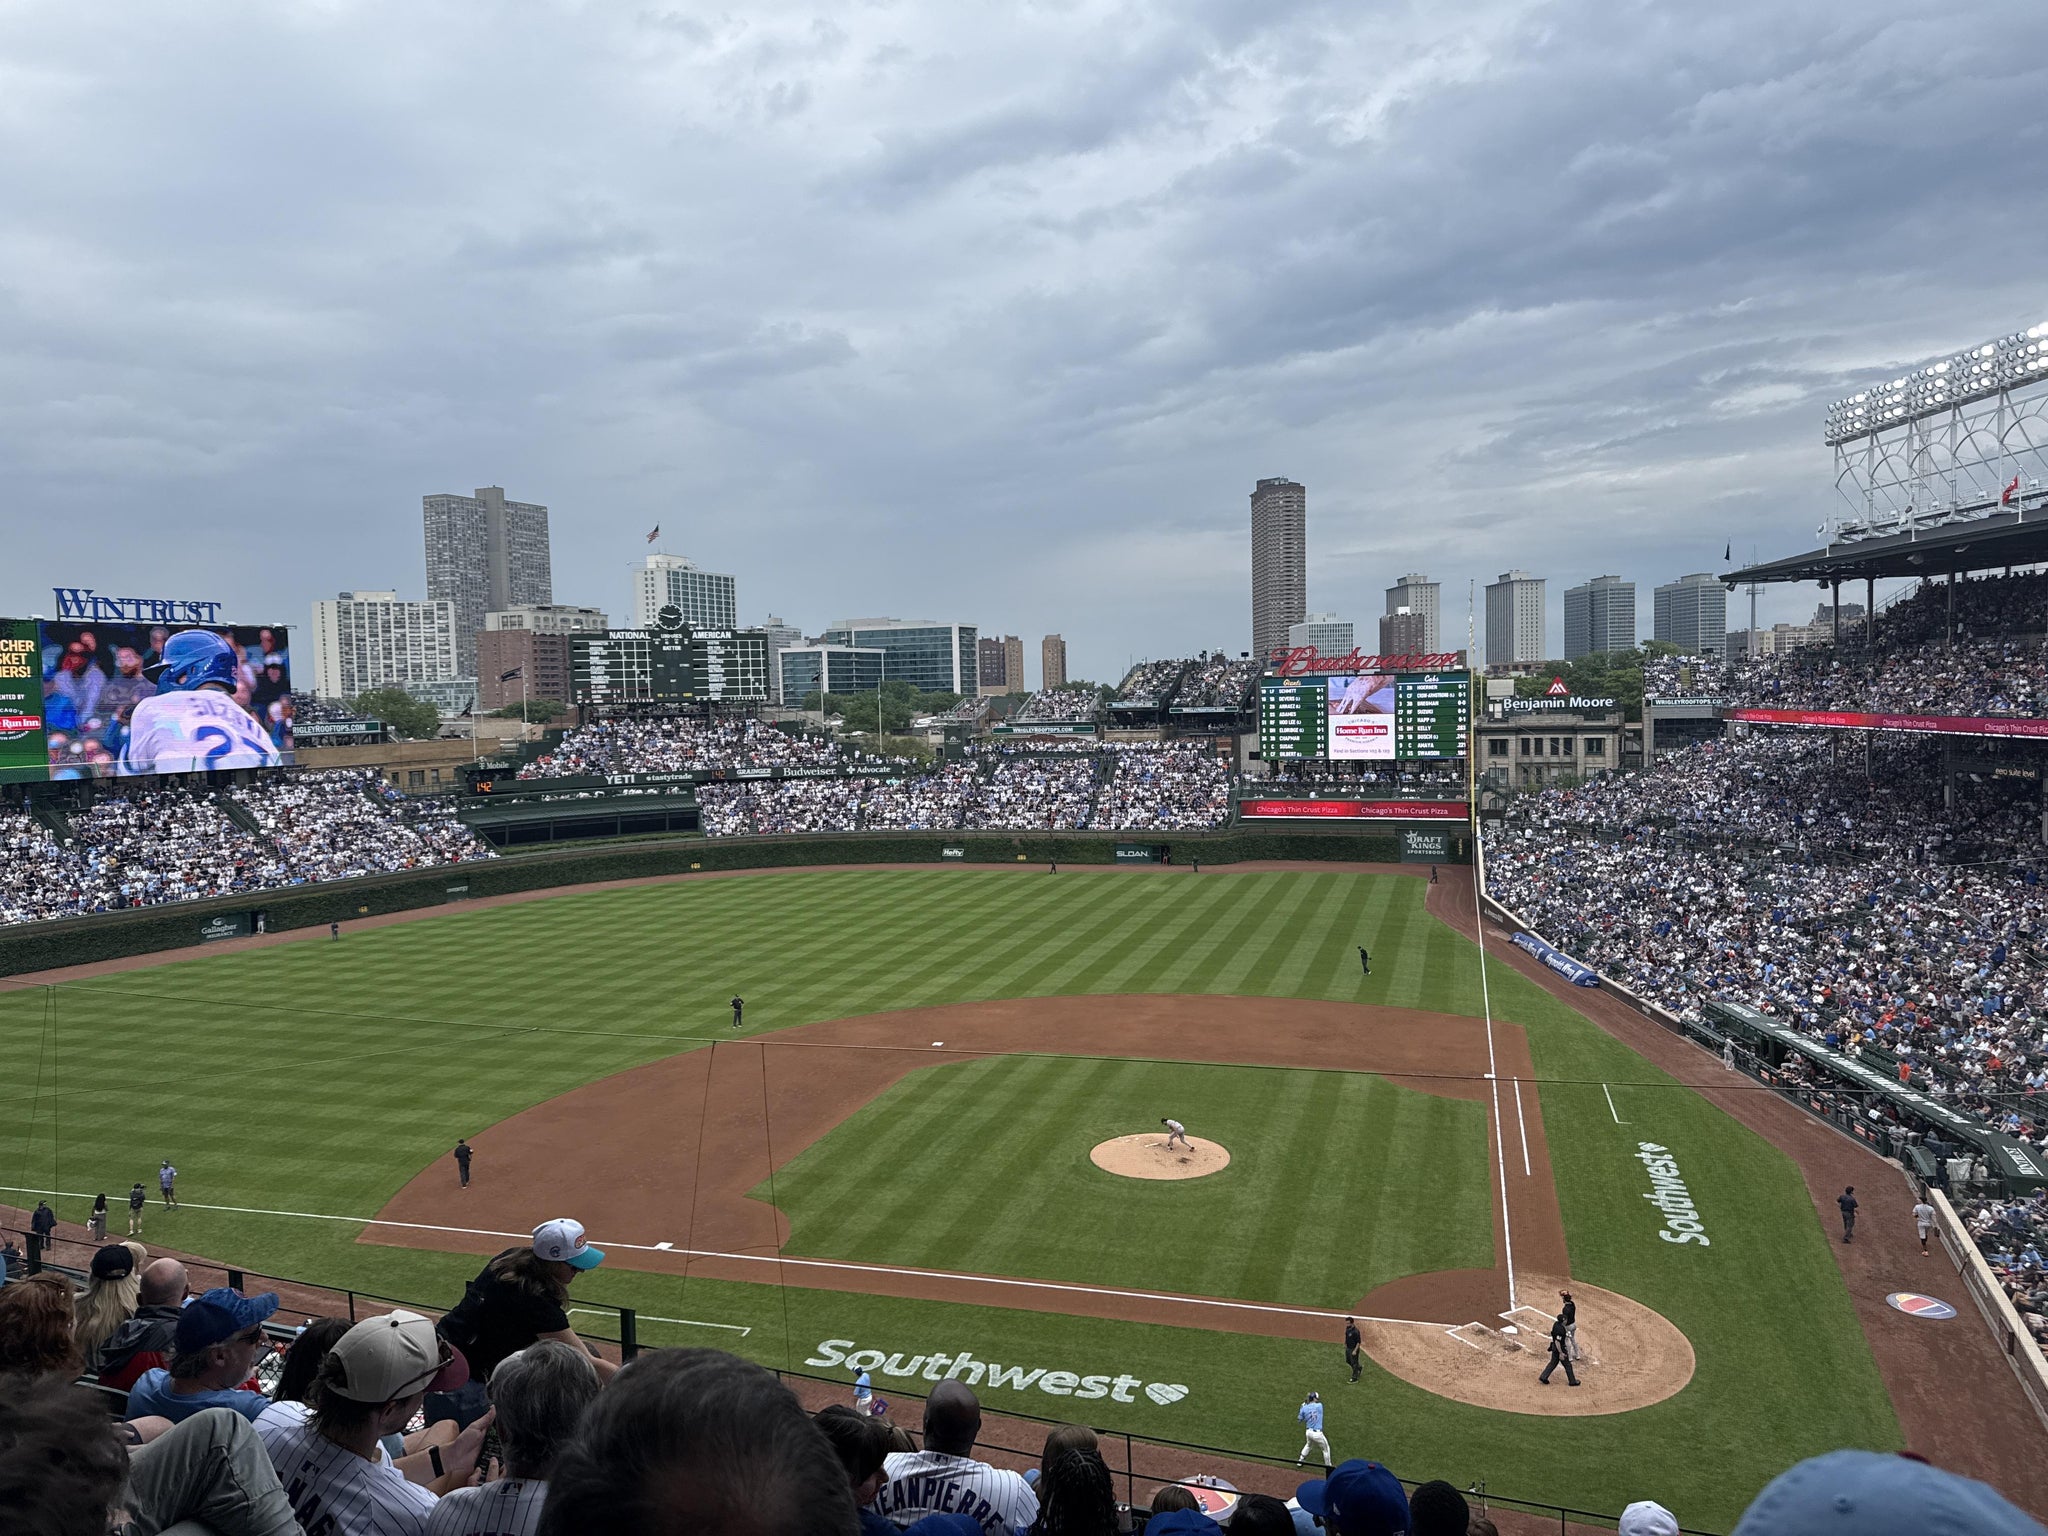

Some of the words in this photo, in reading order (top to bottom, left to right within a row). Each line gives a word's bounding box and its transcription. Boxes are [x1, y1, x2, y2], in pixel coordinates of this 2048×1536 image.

[52, 587, 222, 624] WINTRUST
[609, 631, 651, 639] NATIONAL
[692, 631, 732, 639] AMERICAN
[1270, 645, 1458, 677] Budweiser
[1424, 674, 1439, 683] Cubs
[1503, 697, 1565, 712] Benjamin
[1569, 696, 1614, 708] Moore
[1655, 698, 1723, 706] WRIGLEYROOFTOPS.CO
[3, 719, 22, 728] Run
[1912, 720, 1925, 728] Crust
[1925, 721, 1937, 729] Pizza
[1358, 727, 1373, 735] Run
[1373, 726, 1387, 734] Inn
[1985, 723, 2009, 734] Chicago's
[2010, 725, 2022, 733] Thin
[2023, 726, 2038, 734] Crust
[486, 761, 509, 770] Mobile
[856, 766, 891, 774] Advocate
[736, 768, 772, 776] GRAINGER
[783, 766, 837, 777] Budweiser
[2008, 768, 2022, 776] suite
[2022, 768, 2035, 778] level
[605, 774, 635, 785] YETI
[651, 773, 693, 782] tastytrade
[1256, 806, 1286, 816] Chicago's
[1302, 806, 1321, 814] Crust
[1361, 807, 1393, 816] Chicago's
[1394, 807, 1409, 815] Thin
[1407, 836, 1442, 844] DRAFT
[943, 848, 963, 856] Hefty
[201, 924, 237, 935] Gallagher
[1634, 1151, 1710, 1247] Southwest
[804, 1339, 1142, 1403] Southwest
